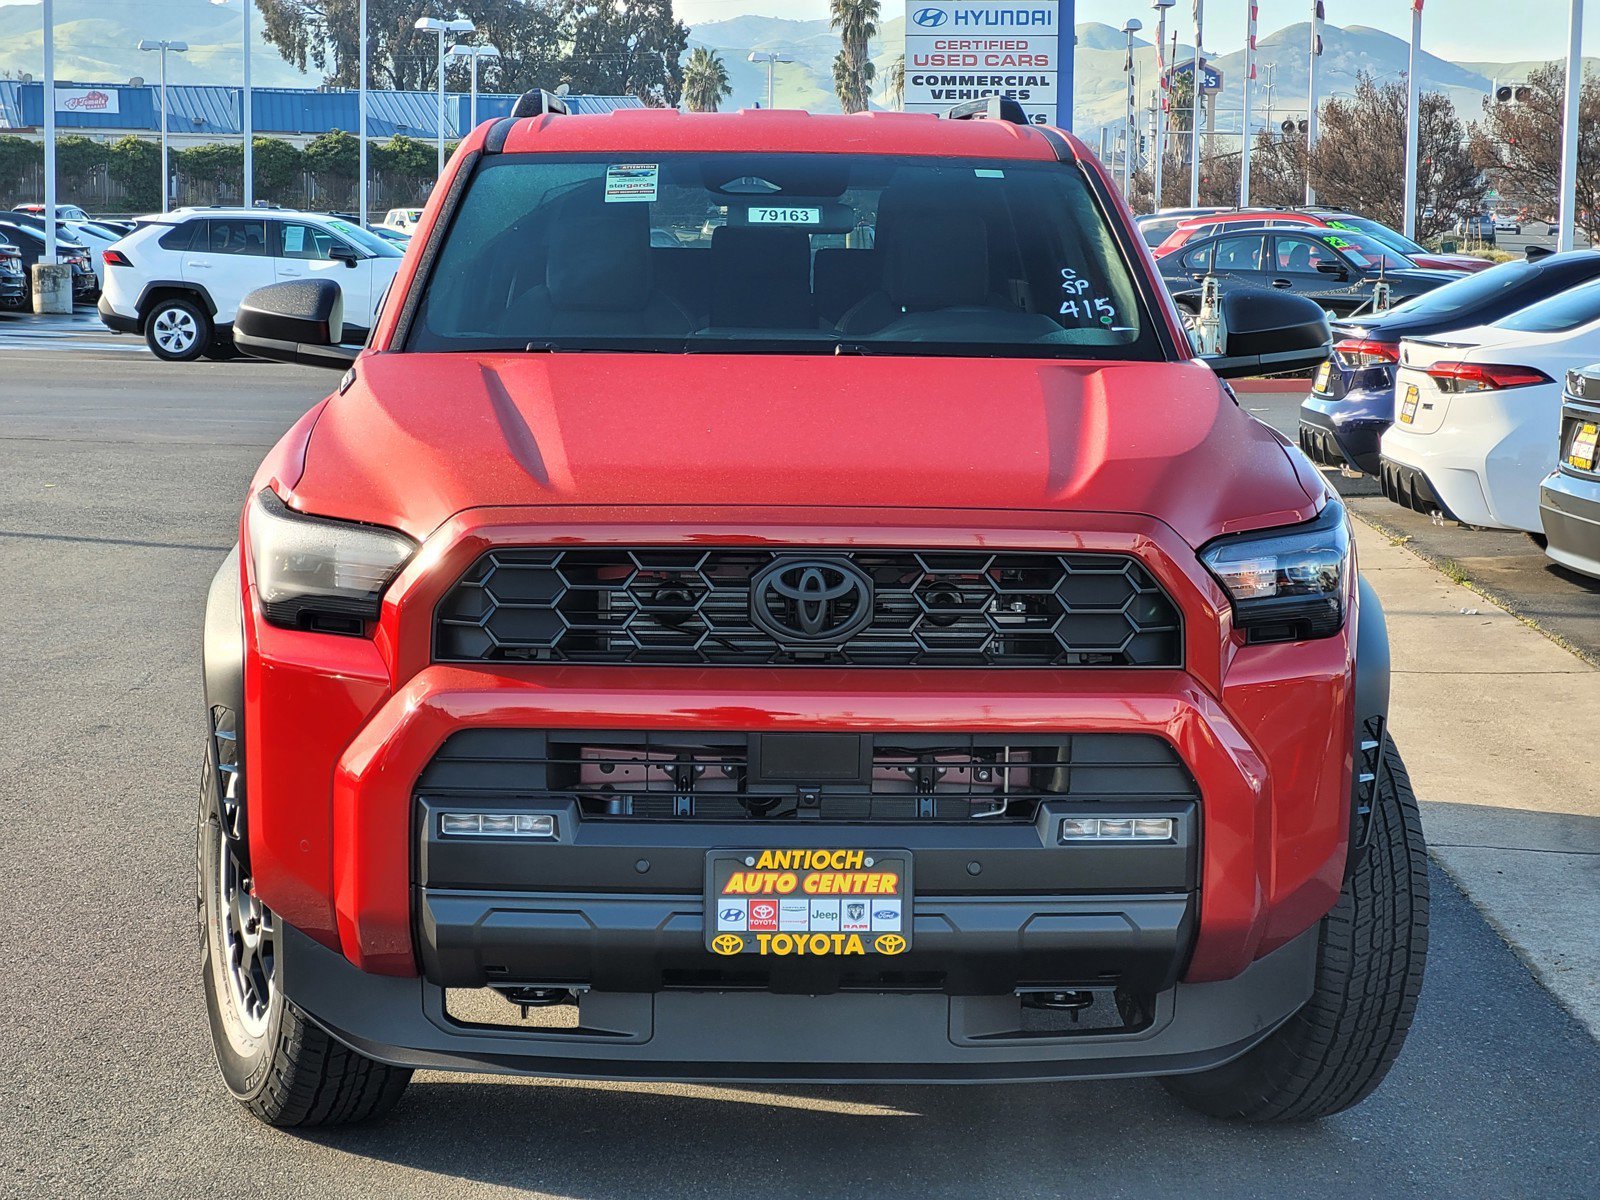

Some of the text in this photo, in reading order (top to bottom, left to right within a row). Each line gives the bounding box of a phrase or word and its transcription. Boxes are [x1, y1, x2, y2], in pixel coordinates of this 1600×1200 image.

[954, 10, 1051, 26] HYUNDAI
[934, 40, 1028, 50] CERTIFIED
[913, 54, 1049, 67] USED CARS
[912, 75, 1050, 87] COMMERCIAL
[758, 210, 810, 221] 79163
[1062, 279, 1089, 295] SP
[1059, 297, 1115, 318] 415
[755, 850, 864, 870] ANTIOCH
[722, 872, 899, 894] AUTO CENTER
[812, 910, 838, 921] Jeep
[878, 911, 894, 920] Ford
[757, 934, 865, 956] TOYOTA
